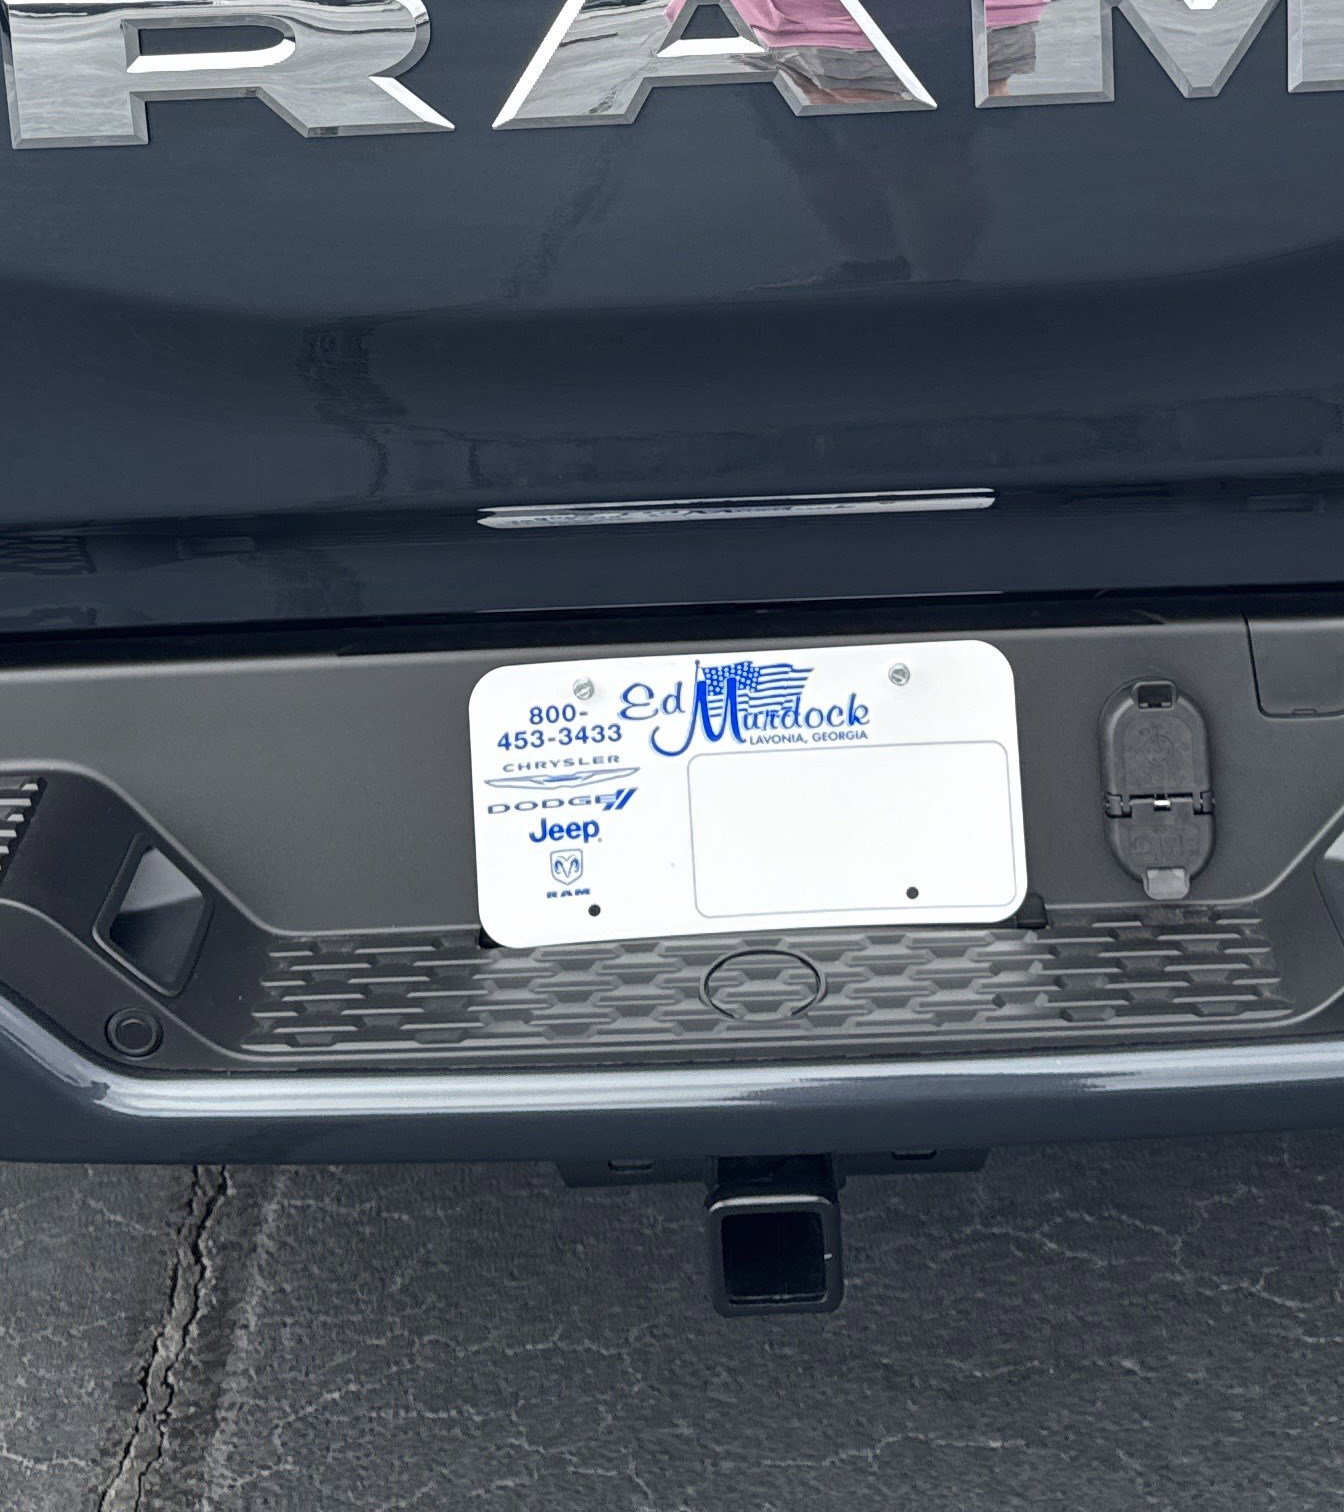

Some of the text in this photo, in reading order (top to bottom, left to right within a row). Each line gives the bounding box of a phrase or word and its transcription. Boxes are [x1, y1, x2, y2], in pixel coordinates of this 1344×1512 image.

[529, 703, 588, 726] 800-
[618, 676, 870, 757] Ed Murdock
[497, 722, 623, 751] 453-3433
[749, 729, 869, 747] LAVONIA, GEORGIA
[502, 754, 621, 774] CHRYSLER
[487, 792, 618, 815] DODGE
[528, 816, 601, 844] Jeep
[546, 887, 592, 900] RAM
